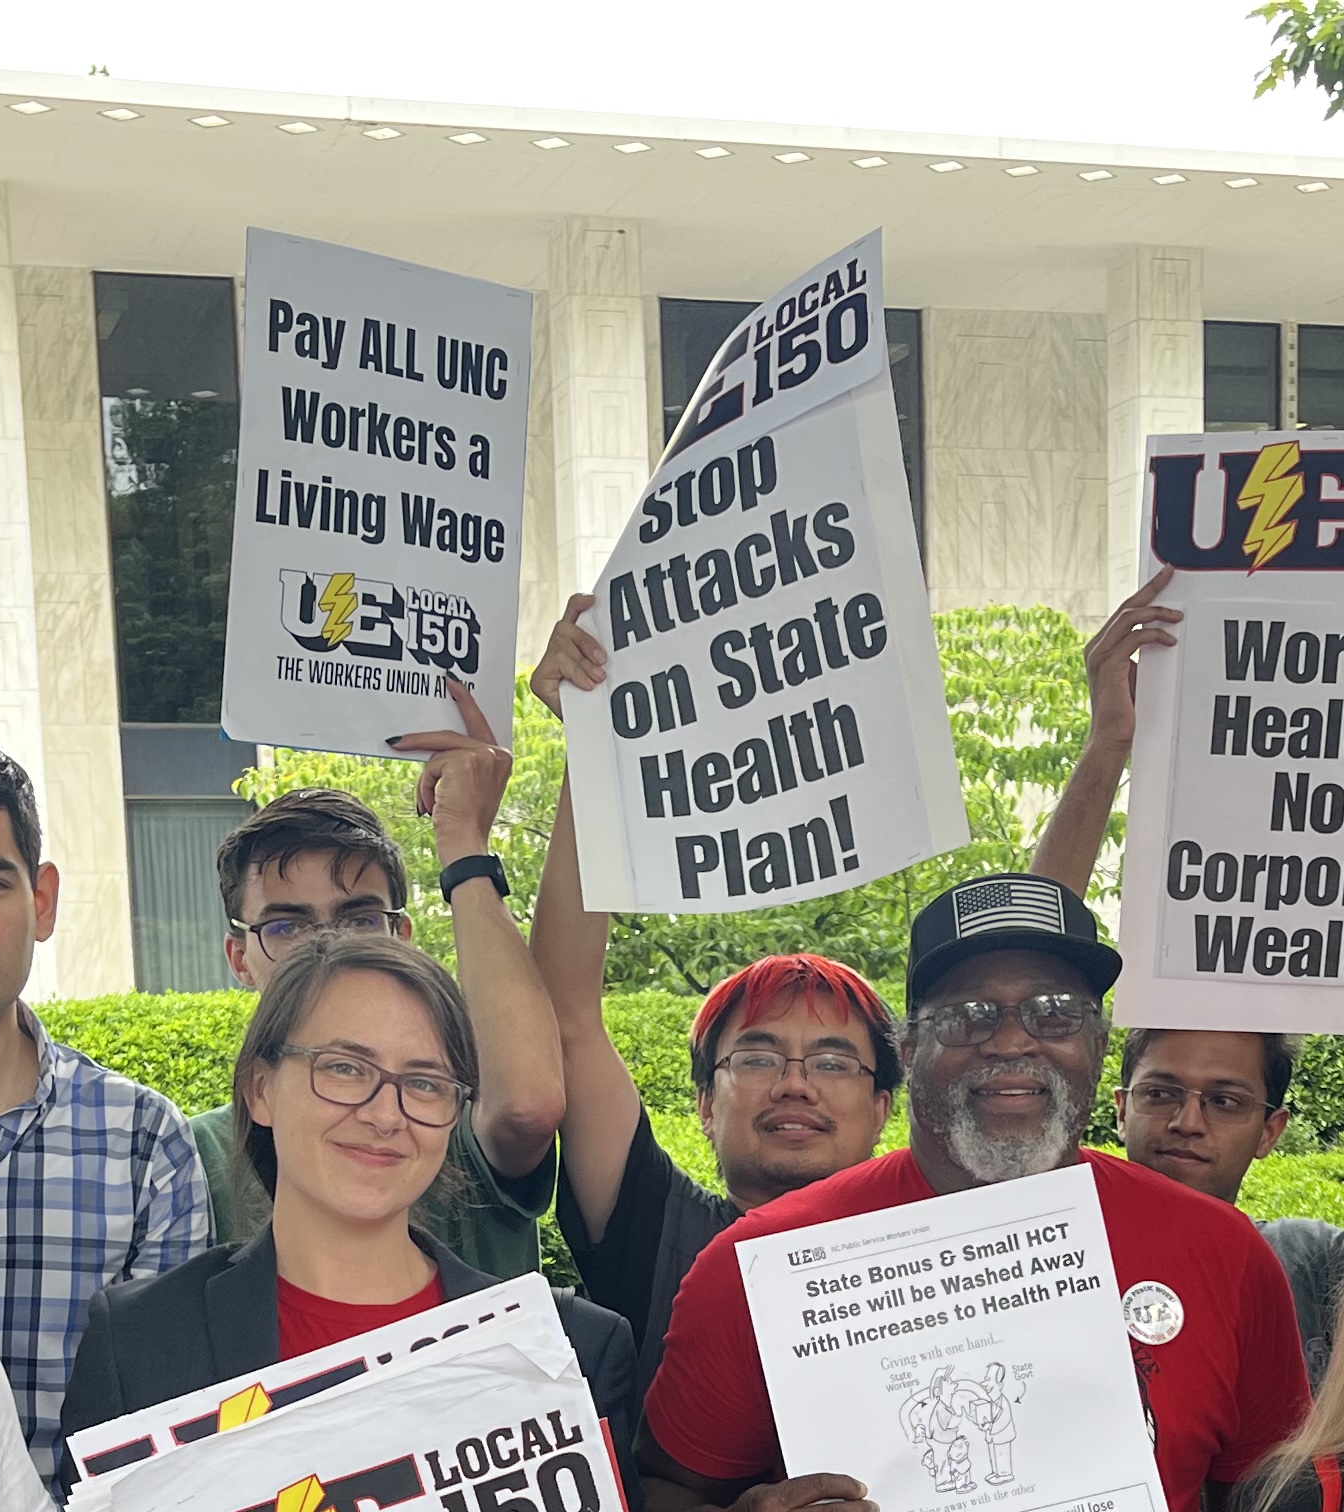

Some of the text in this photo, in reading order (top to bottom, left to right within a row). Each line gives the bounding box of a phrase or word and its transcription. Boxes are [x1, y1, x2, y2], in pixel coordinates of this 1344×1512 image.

[754, 257, 866, 345] LOCAL
[268, 298, 509, 401] Pay ALL UNC
[752, 292, 870, 406] 150
[281, 386, 491, 480] Workers a
[256, 468, 505, 563] Living Wage
[639, 435, 776, 544] Stop
[279, 568, 402, 661] UE
[406, 586, 472, 618] LOCAL
[609, 502, 855, 651] Attacks
[276, 656, 302, 683] THE
[308, 659, 382, 691] WORKERS
[386, 671, 429, 697] UNION
[406, 610, 481, 675] 150
[609, 593, 887, 739] on State
[639, 701, 864, 817] Health
[675, 794, 859, 898] Plan!
[801, 1249, 1084, 1327] Raise will be Washed Away
[805, 1222, 1068, 1297] State Bonus & Small HCT
[792, 1275, 1100, 1358] with Increases to Health Plan
[425, 1409, 581, 1491] LOCAL
